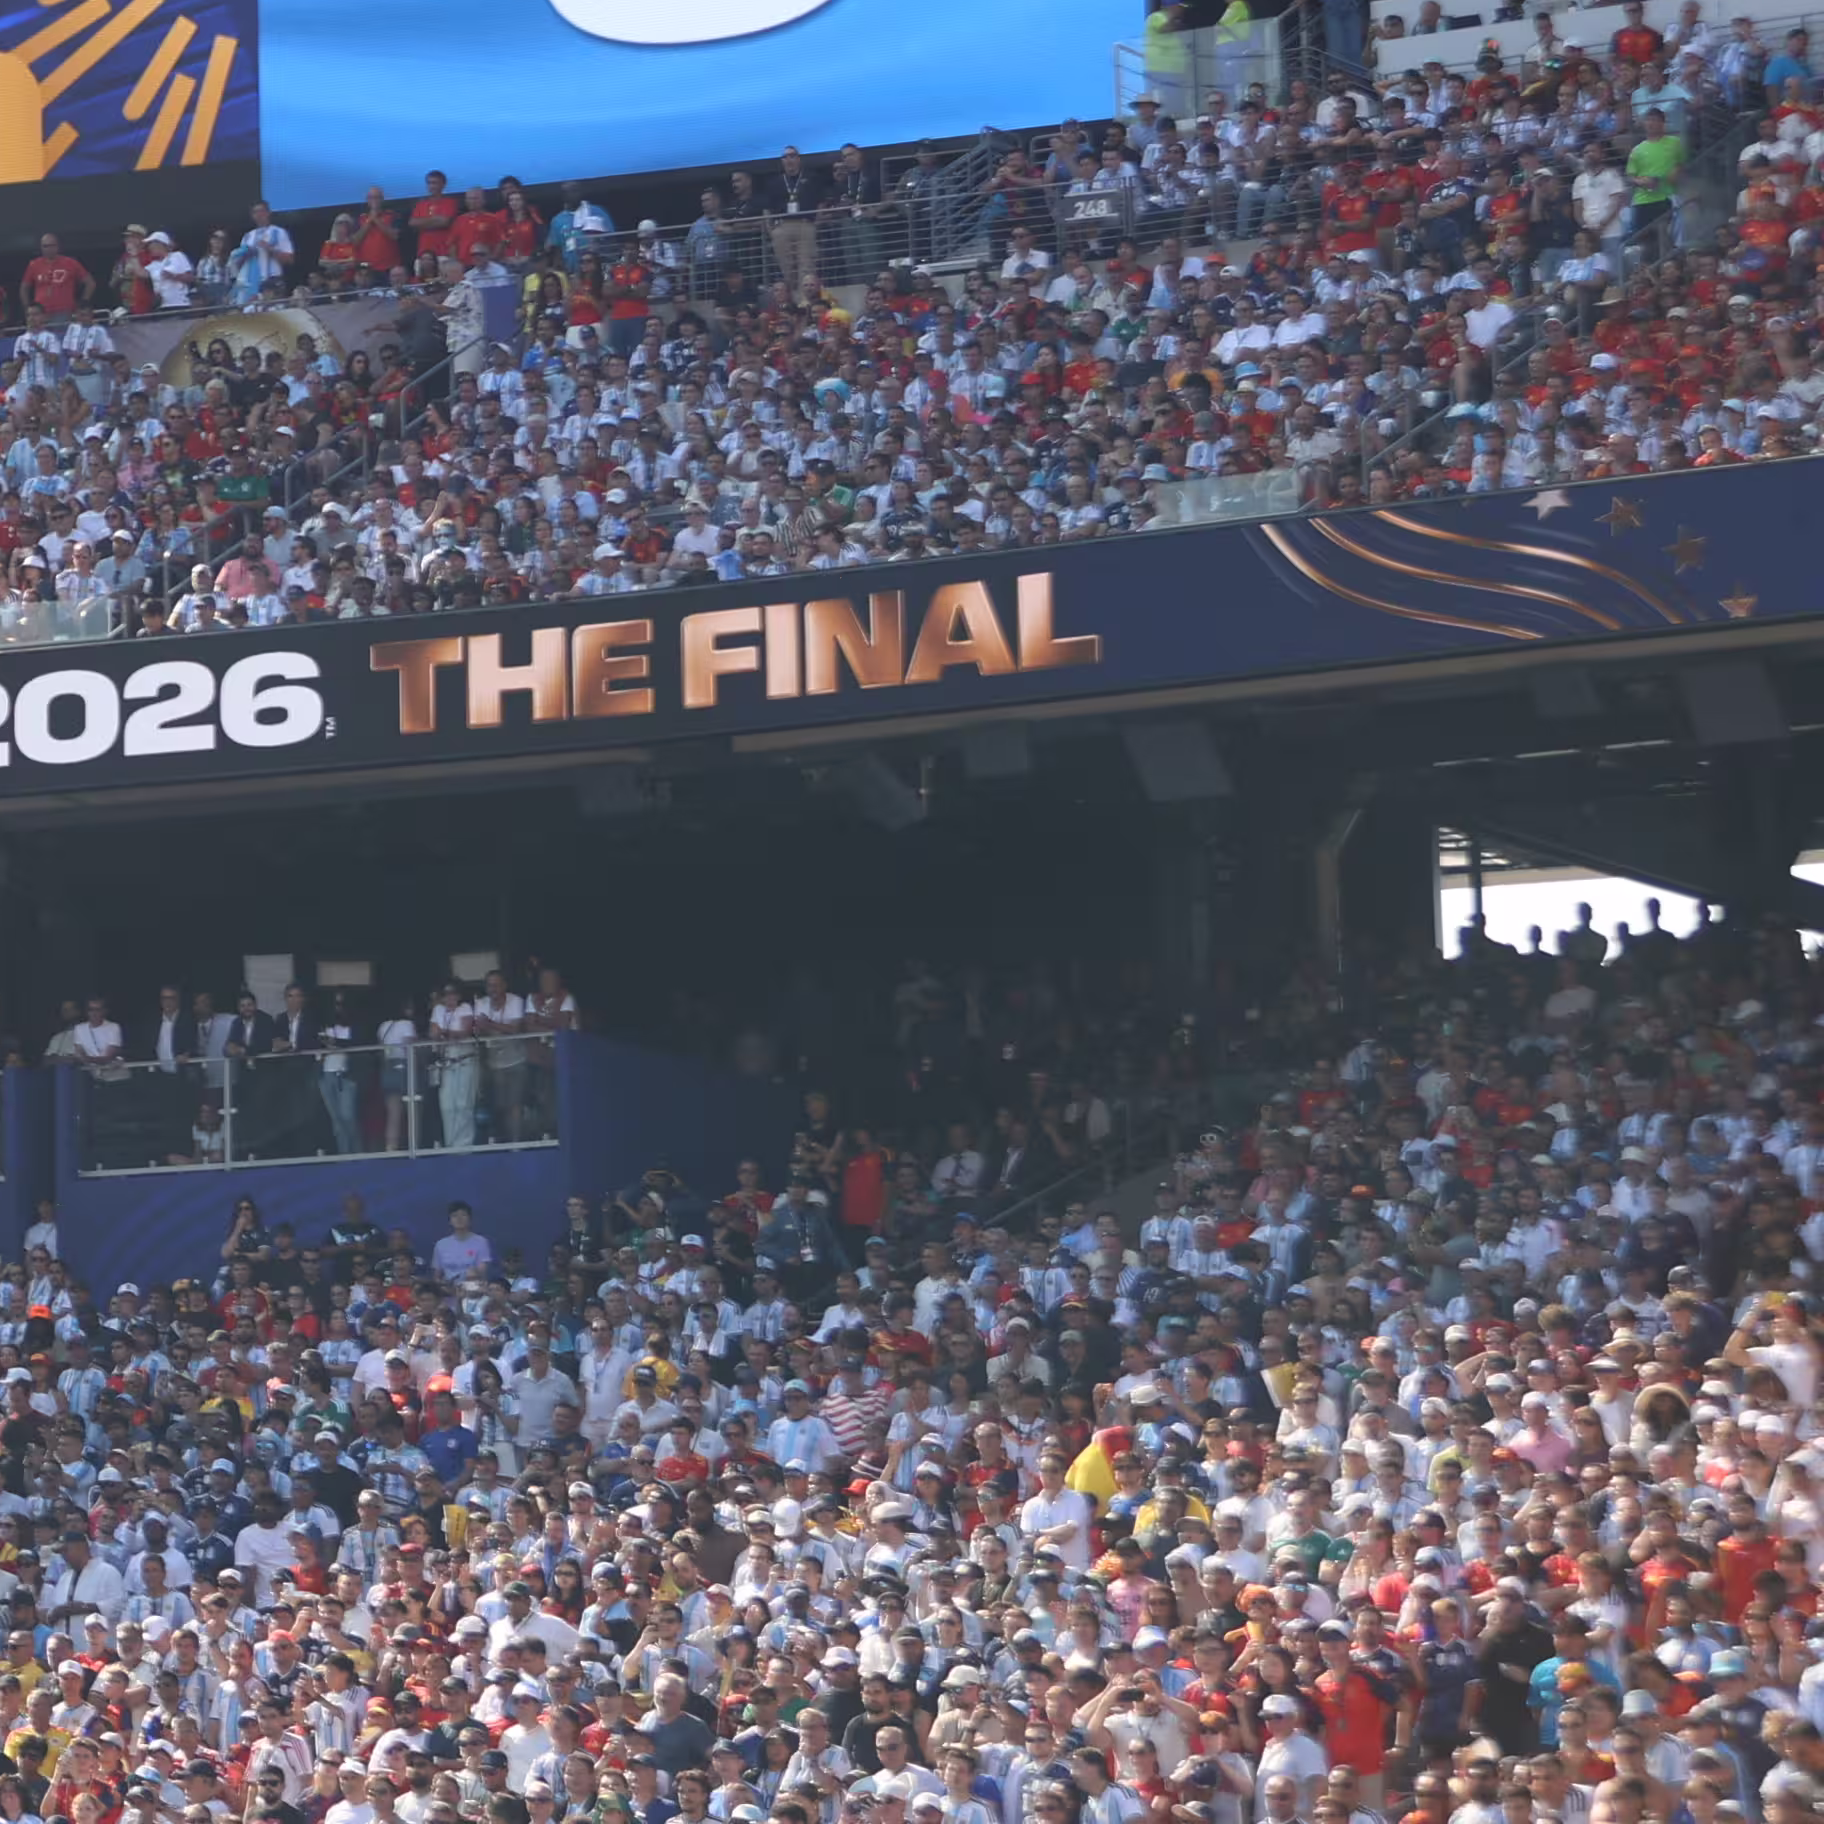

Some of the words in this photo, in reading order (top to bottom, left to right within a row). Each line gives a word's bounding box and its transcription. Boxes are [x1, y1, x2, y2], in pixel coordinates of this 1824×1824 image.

[1074, 199, 1107, 218] 248
[369, 619, 657, 736] THE
[681, 572, 1101, 710] FINAL
